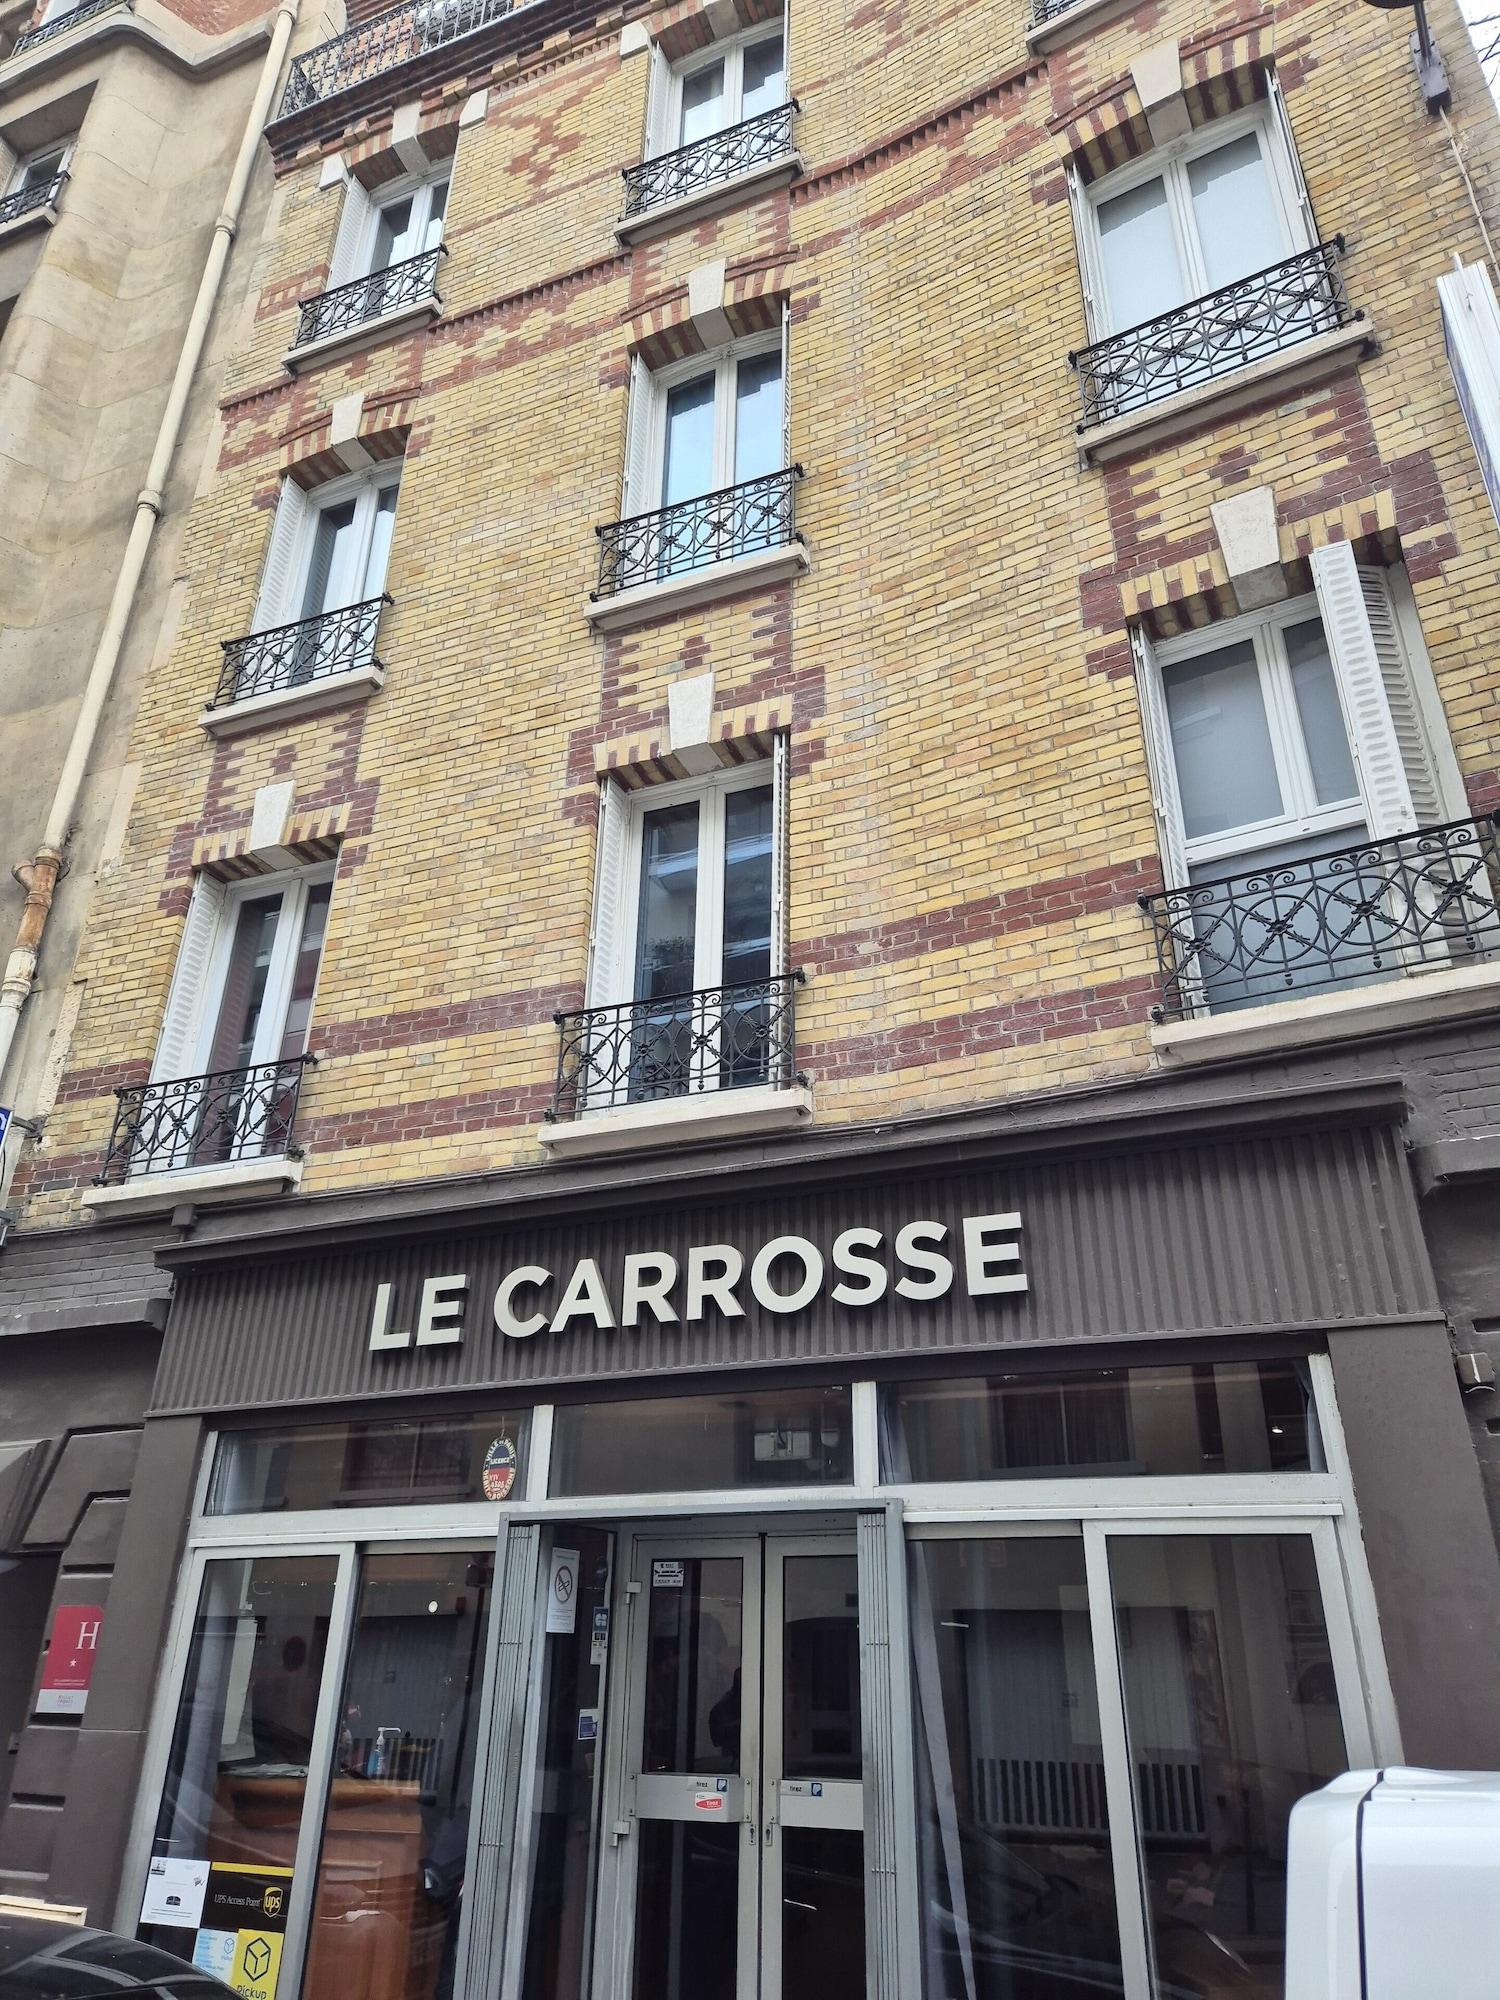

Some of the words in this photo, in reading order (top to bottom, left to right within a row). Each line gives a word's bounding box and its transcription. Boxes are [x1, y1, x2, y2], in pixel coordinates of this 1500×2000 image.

[369, 1273, 469, 1351] LE
[494, 1212, 1028, 1338] CARROSSE
[485, 1440, 499, 1462] VILLE
[504, 1439, 515, 1459] PARIS
[490, 1457, 510, 1465] LICENCE
[75, 1621, 102, 1650] H
[789, 1785, 802, 1793] tirez
[214, 1893, 227, 1904] UPS
[227, 1896, 246, 1906] Access
[245, 1897, 261, 1907] Point
[265, 1896, 281, 1913] ups
[237, 1984, 267, 2000] Pickup
